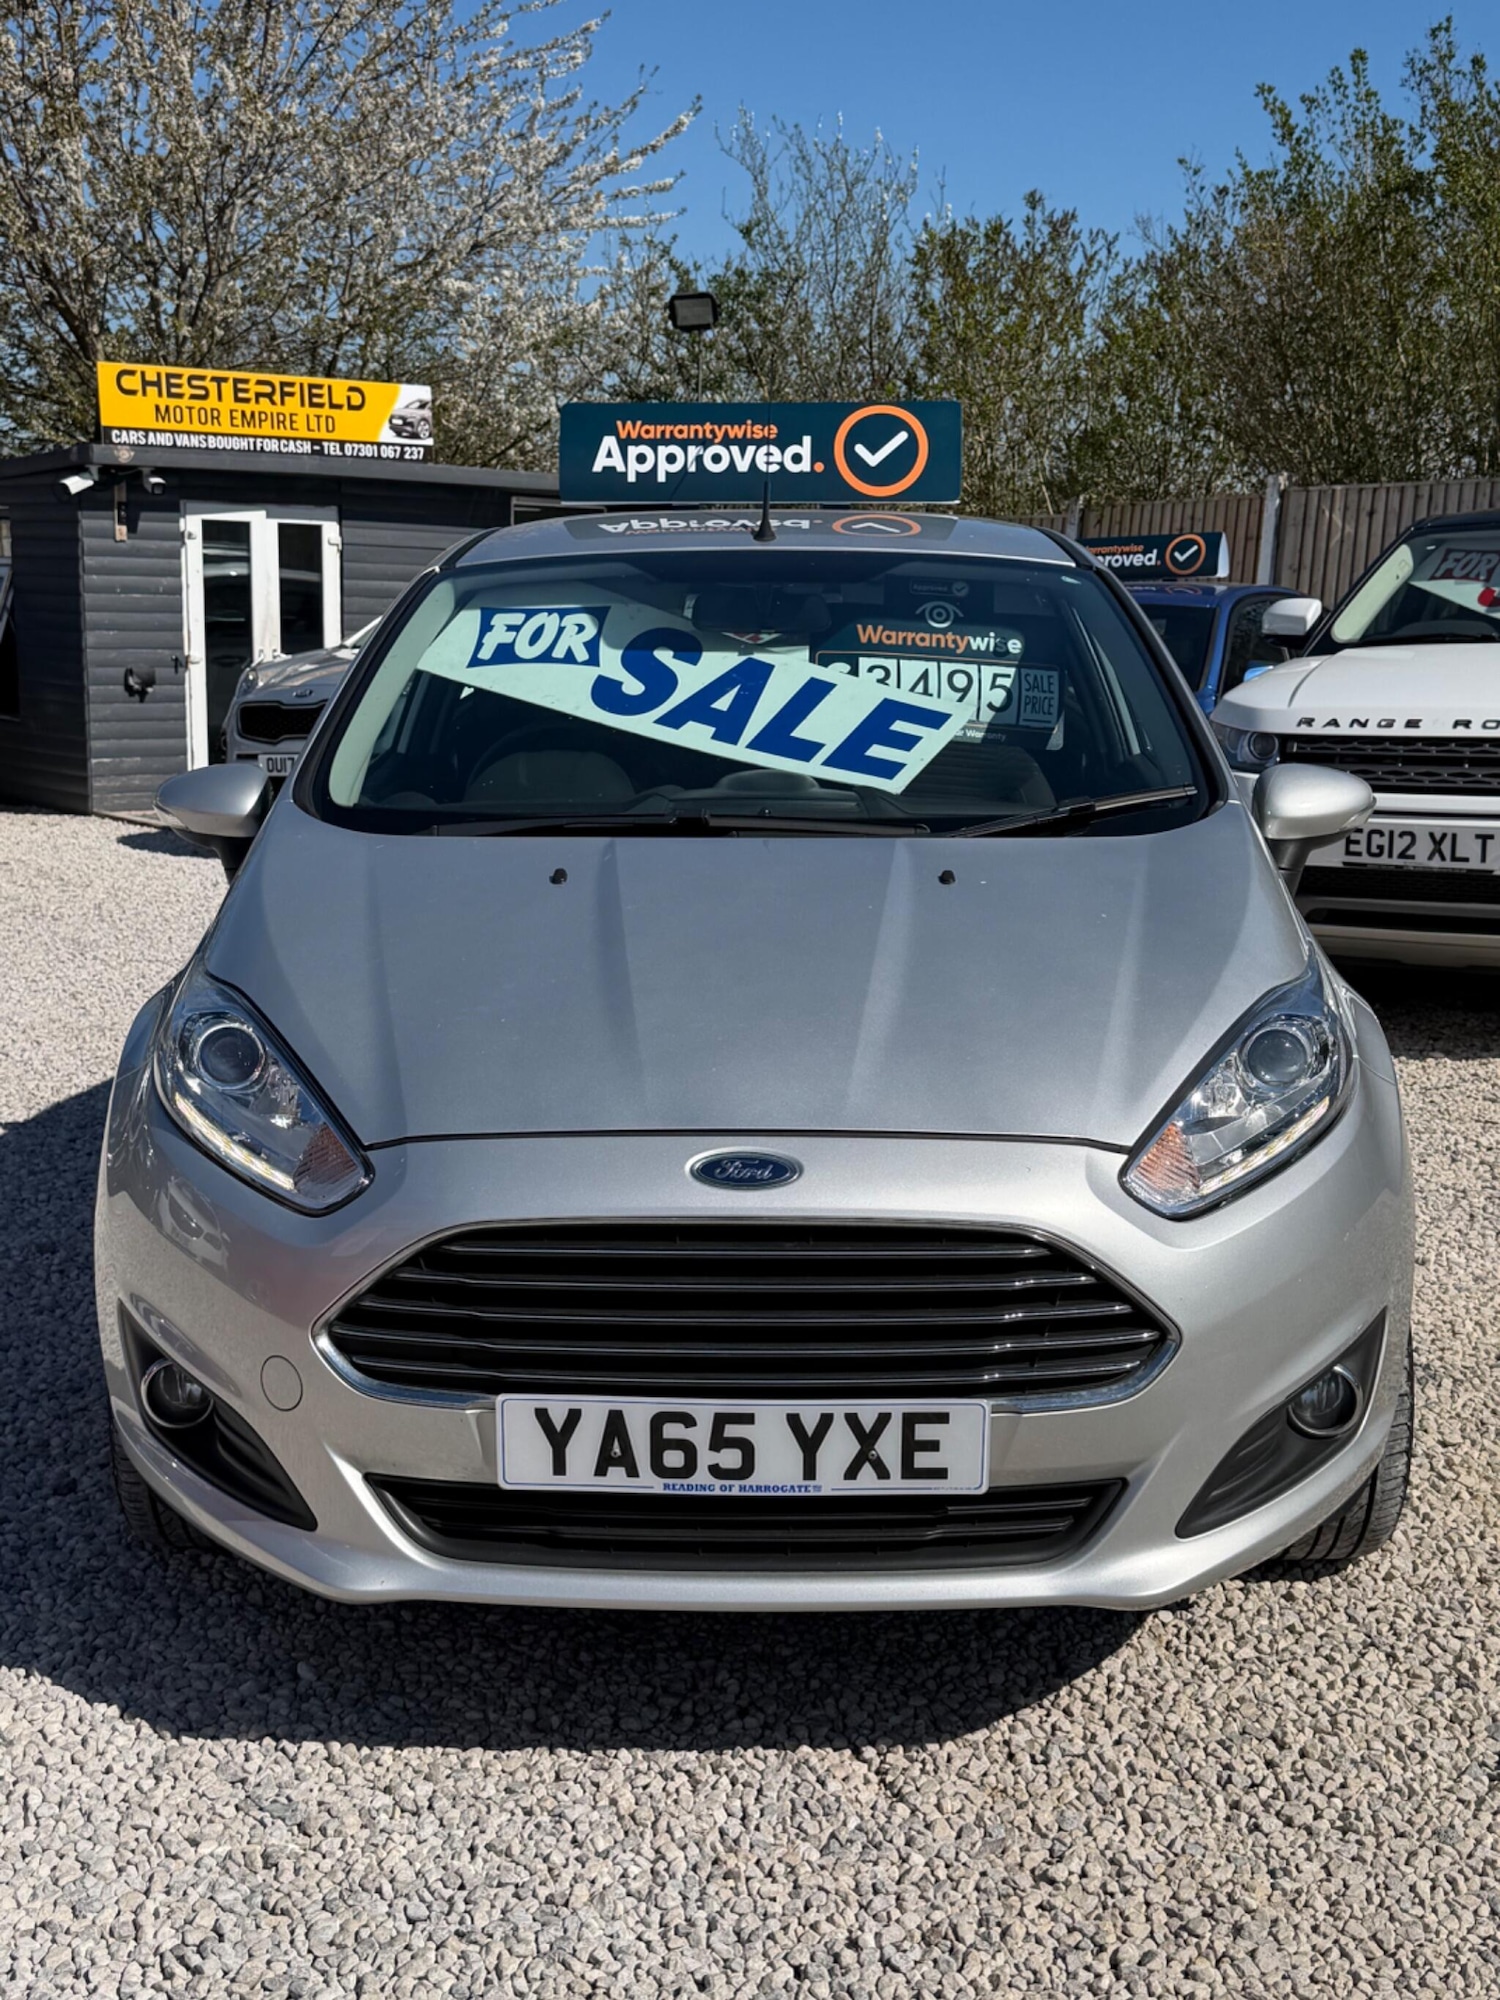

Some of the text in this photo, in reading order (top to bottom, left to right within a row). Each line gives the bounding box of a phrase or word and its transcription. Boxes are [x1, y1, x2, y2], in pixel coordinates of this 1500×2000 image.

[115, 368, 367, 412] CHESTERFIELD
[154, 404, 337, 434] MOTOR EMPIRE LTD
[615, 419, 779, 444] Warrantywise
[111, 429, 146, 445] CARS
[147, 431, 174, 447] AND
[173, 432, 207, 449] VANS
[207, 434, 257, 451] BOUGHT
[256, 437, 279, 453] FOR
[279, 438, 312, 454] CASH
[322, 442, 343, 456] TEL
[344, 442, 378, 458] 07301
[380, 445, 401, 459] 067
[403, 446, 425, 460] 237
[591, 435, 825, 483] Approved.
[1086, 543, 1145, 555] arrantywise
[1434, 551, 1500, 580] FOR
[856, 623, 1022, 654] Warrantywise
[477, 610, 952, 781] FOR SALE
[1023, 673, 1055, 695] SALE
[1023, 694, 1055, 716] PRICE
[1296, 717, 1423, 729] RANGE
[1344, 828, 1495, 864] EG12 XLT
[714, 1159, 774, 1180] Ford
[533, 1407, 951, 1481] YA65 YXE
[662, 1482, 716, 1492] READING
[719, 1483, 735, 1492] OF
[738, 1484, 813, 1493] HARROGATE
